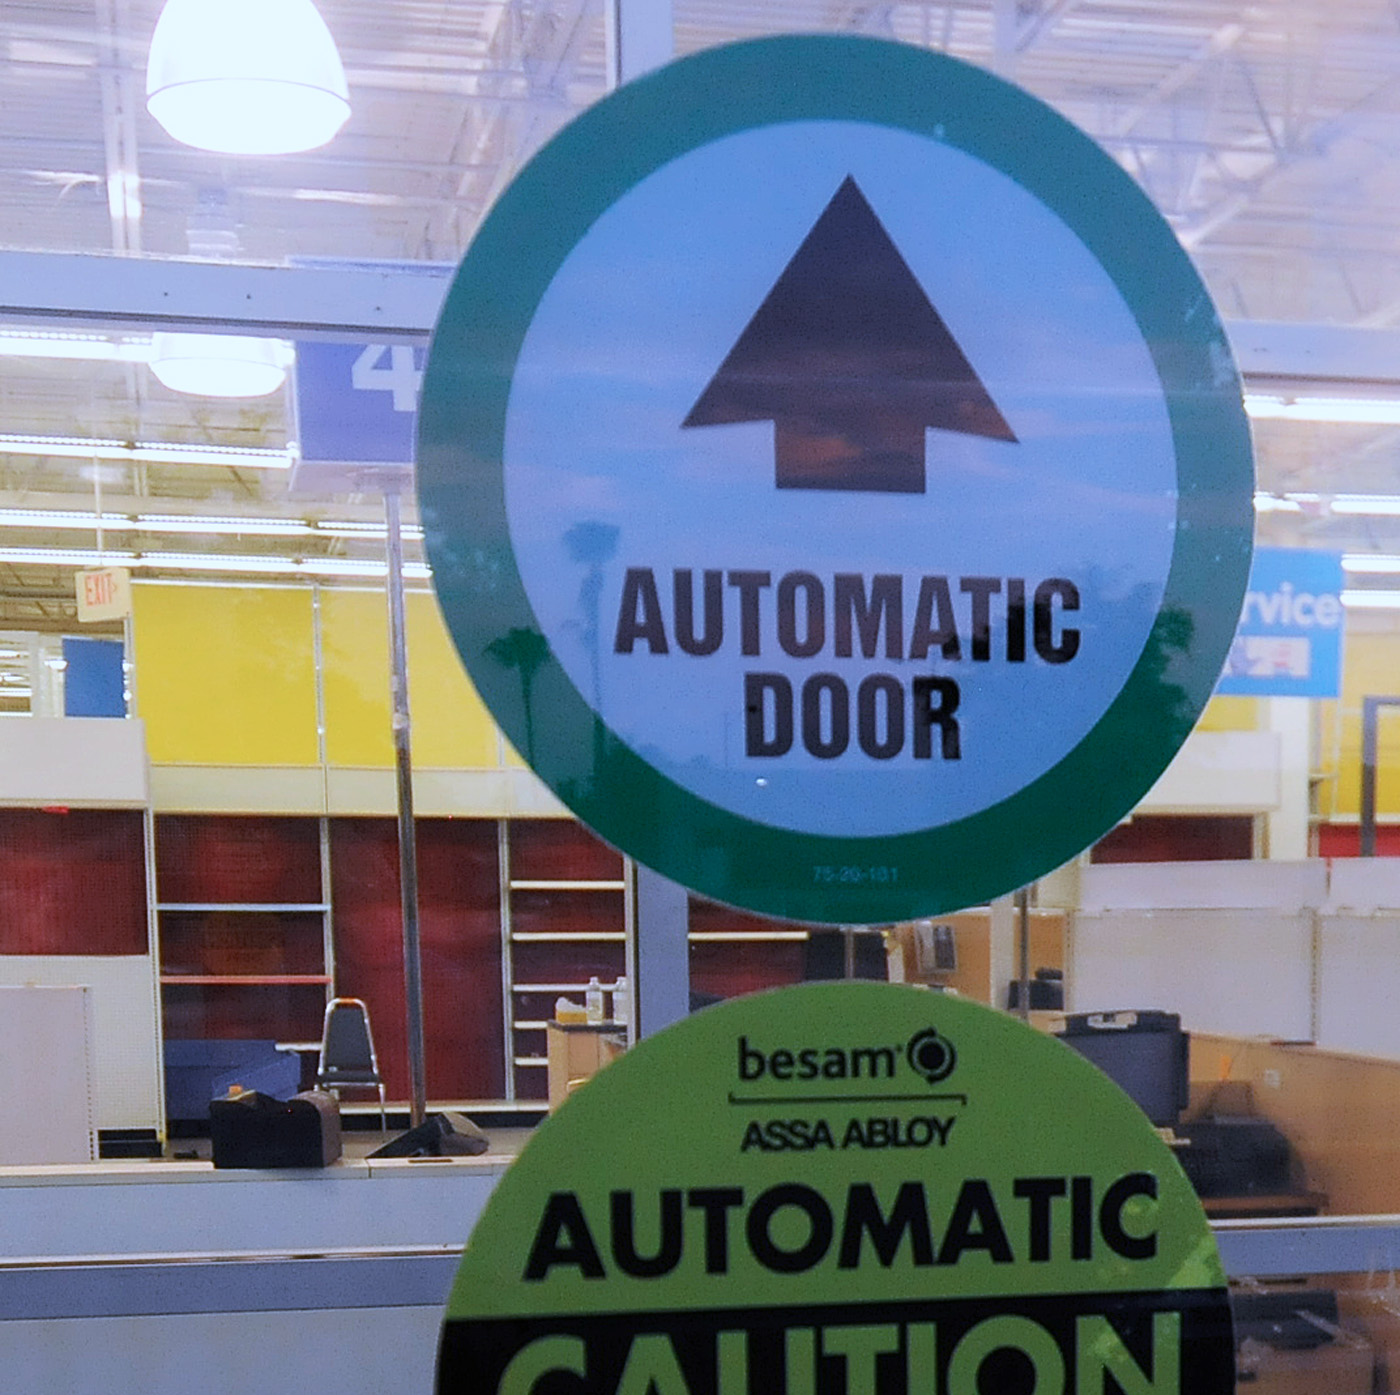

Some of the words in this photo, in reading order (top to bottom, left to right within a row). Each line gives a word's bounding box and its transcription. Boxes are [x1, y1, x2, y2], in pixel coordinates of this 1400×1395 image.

[352, 344, 423, 412] 4
[84, 573, 112, 607] EXIT
[613, 567, 1082, 664] AUTOMATIC
[743, 671, 962, 760] DOOR
[741, 1120, 835, 1151] ASSA
[841, 1116, 956, 1149] ABLOY
[522, 1173, 1159, 1283] AUTOMATIC
